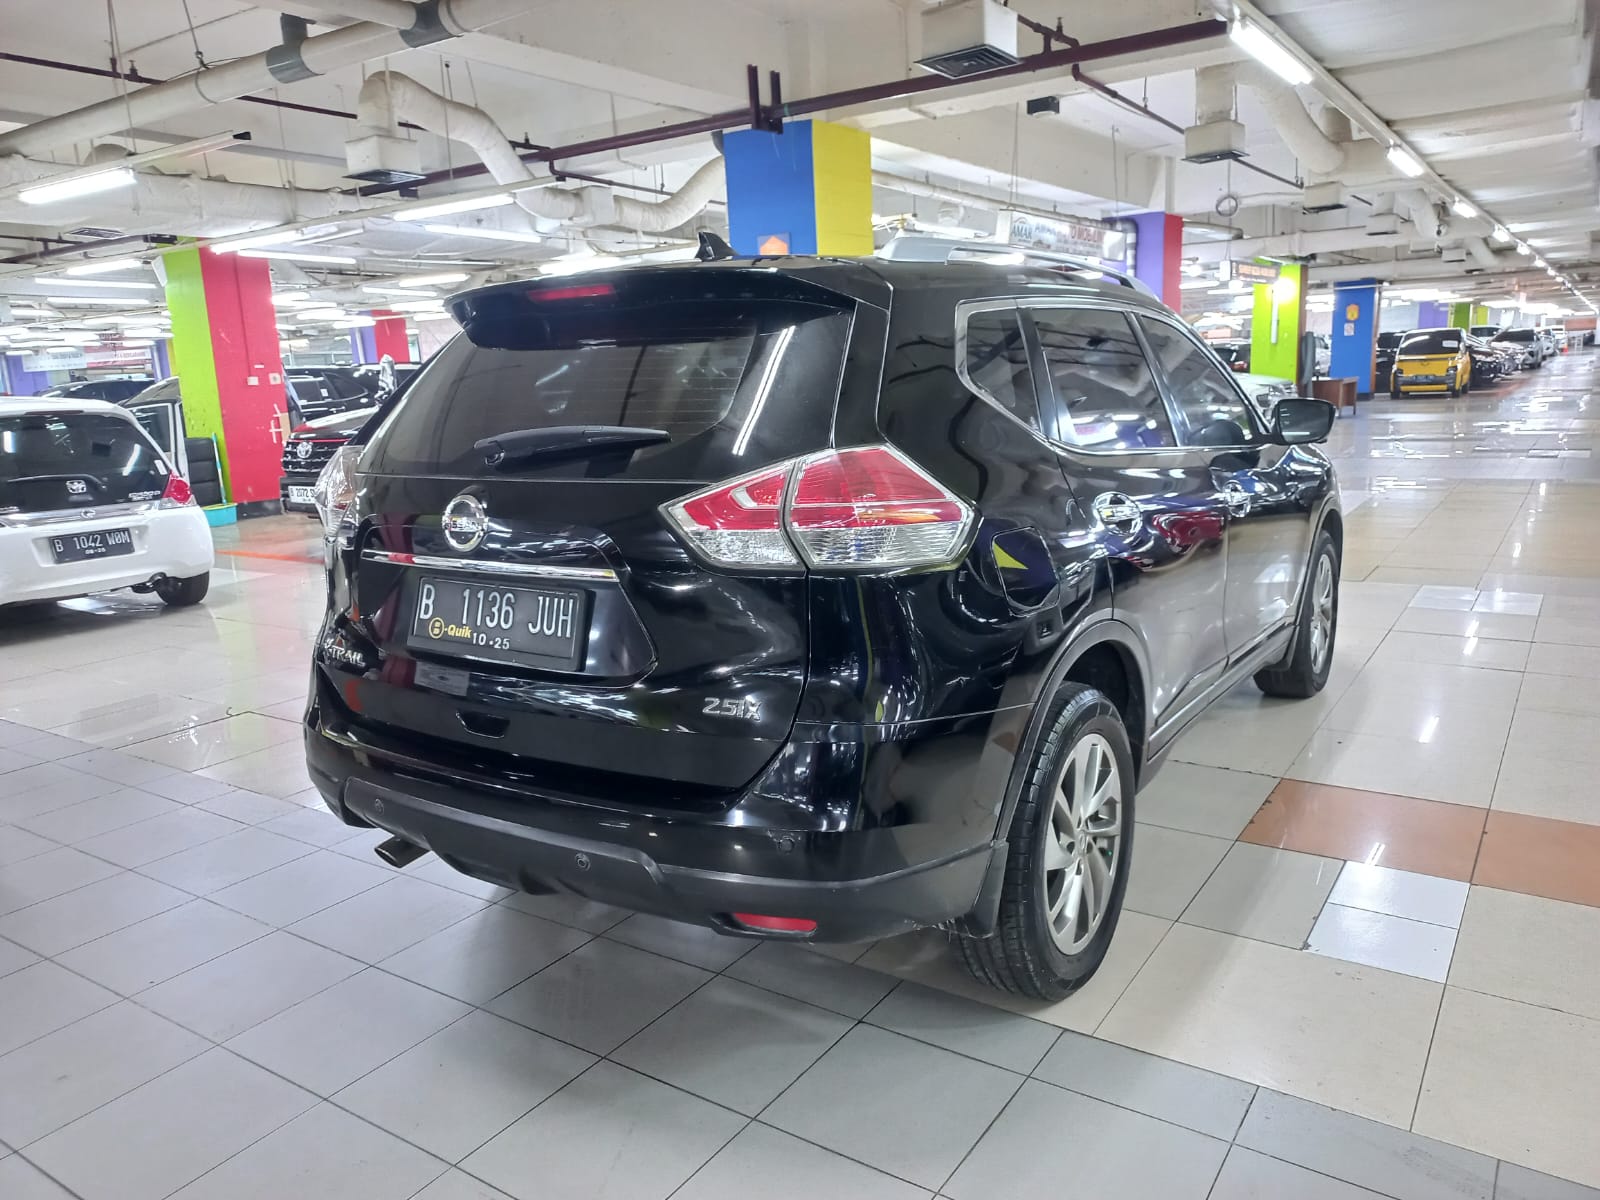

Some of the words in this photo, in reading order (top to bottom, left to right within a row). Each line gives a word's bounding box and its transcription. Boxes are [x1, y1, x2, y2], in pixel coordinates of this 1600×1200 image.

[54, 539, 64, 552] B
[73, 534, 103, 549] 1042
[420, 584, 435, 620] B
[462, 588, 515, 630] 1136
[528, 596, 574, 639] JUH
